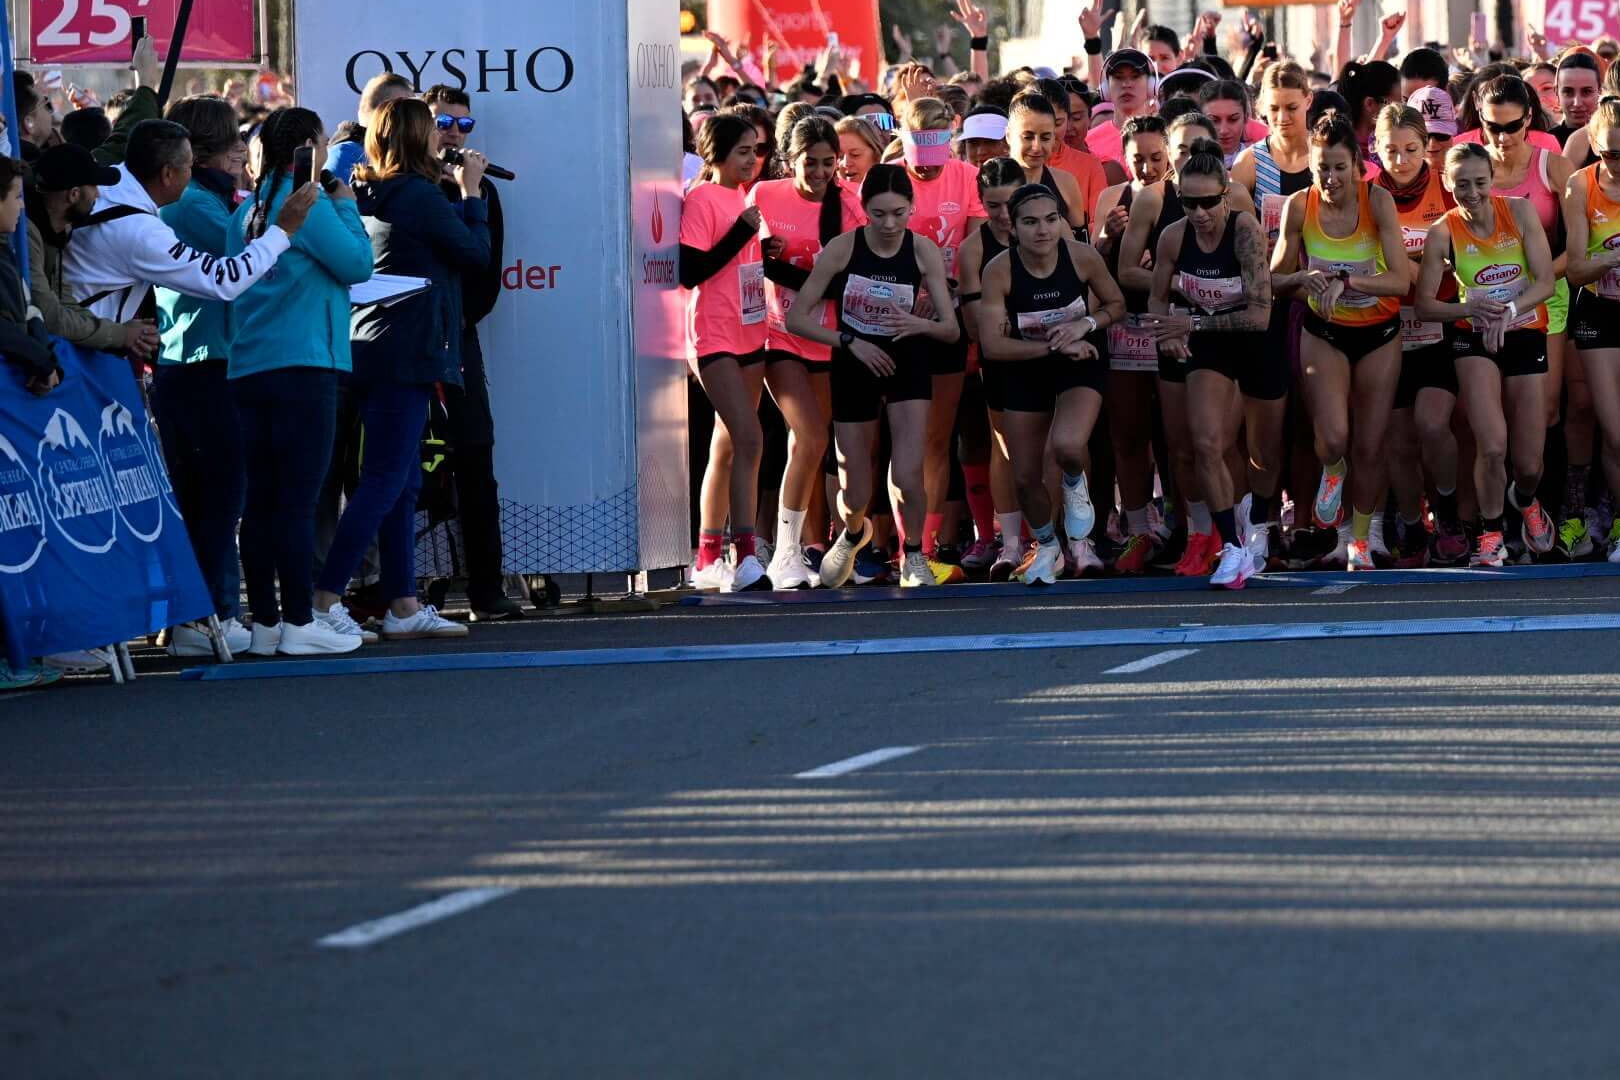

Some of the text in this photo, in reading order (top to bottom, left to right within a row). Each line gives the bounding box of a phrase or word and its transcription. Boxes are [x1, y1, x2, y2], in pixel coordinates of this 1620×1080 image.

[344, 46, 575, 95] OYSHO
[636, 42, 675, 89] OYSHO
[1420, 98, 1442, 120] NY
[1478, 266, 1520, 283] Serrano
[1033, 290, 1060, 300] OYSHO
[1198, 289, 1223, 299] 016
[1126, 337, 1150, 348] 016
